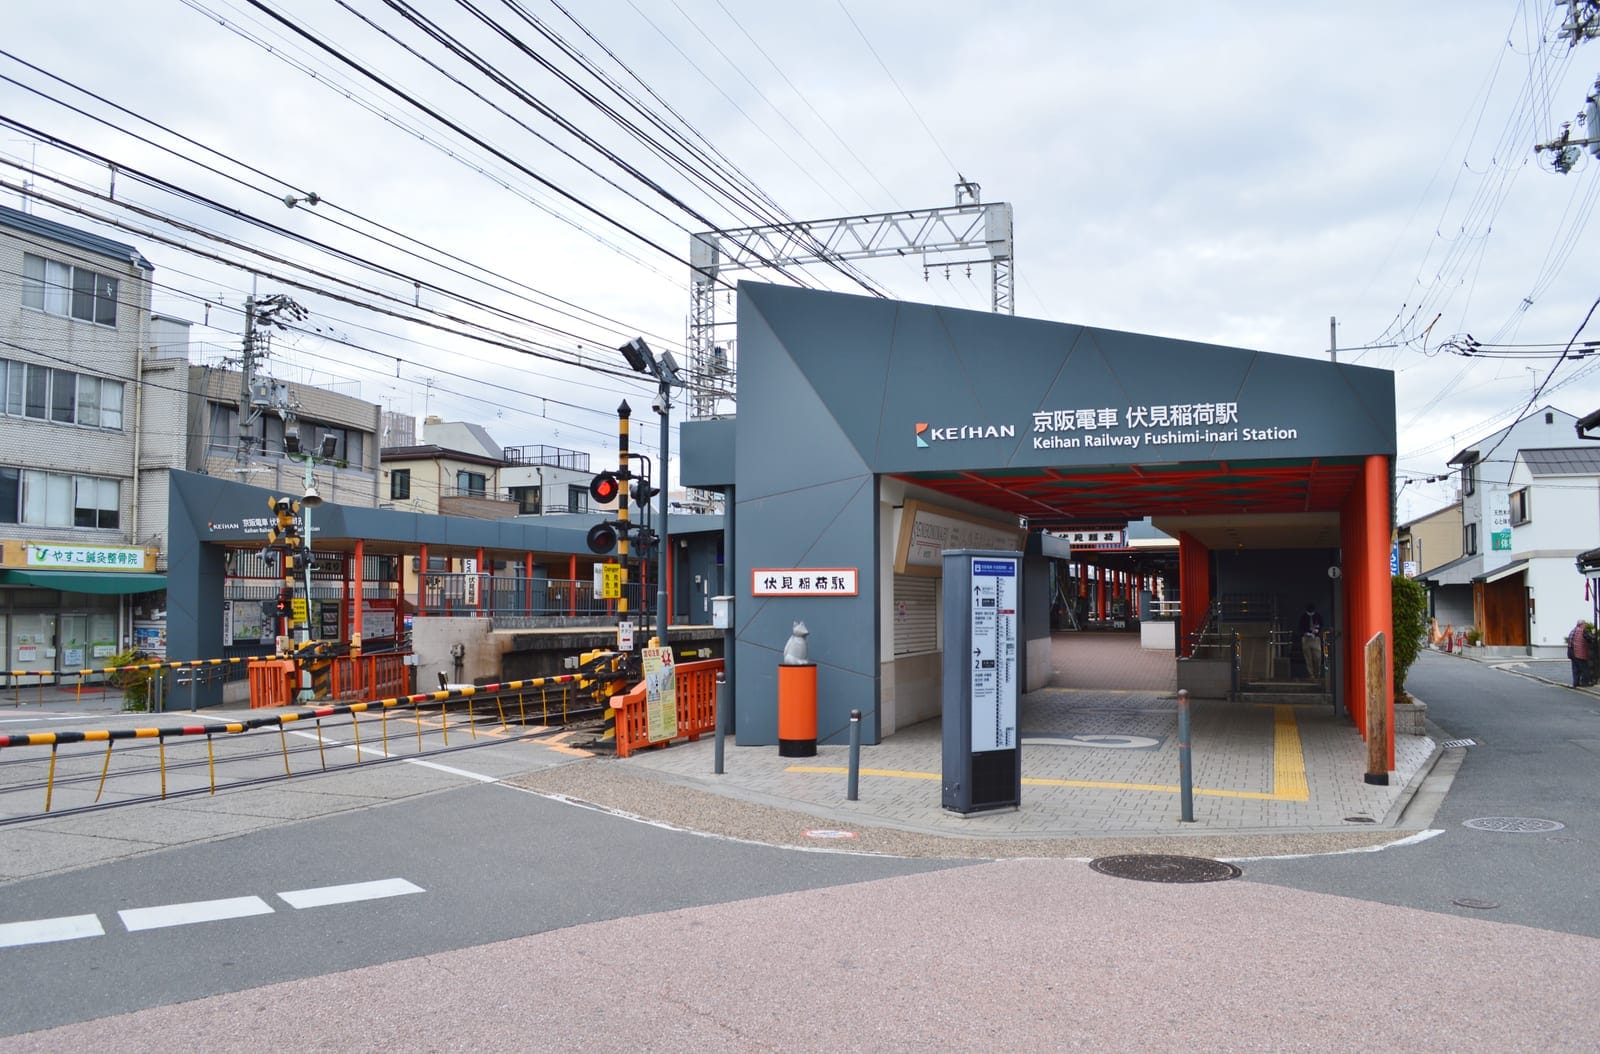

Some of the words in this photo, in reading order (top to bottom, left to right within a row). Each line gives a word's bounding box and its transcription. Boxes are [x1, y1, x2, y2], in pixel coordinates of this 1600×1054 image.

[1032, 407, 1118, 432] 京阪電車
[1126, 402, 1239, 429] 伏見稲荷駅
[931, 424, 1015, 441] KEIHAN
[1033, 435, 1080, 449] Keihan
[1084, 432, 1140, 448] Railway
[1145, 429, 1238, 445] Fushimi-inari
[1243, 426, 1297, 442] Station
[53, 549, 138, 565] やすこ鍼灸整骨院
[763, 576, 846, 590] 伏見稲荷駅
[975, 598, 980, 607] 1
[975, 660, 980, 669] 2
